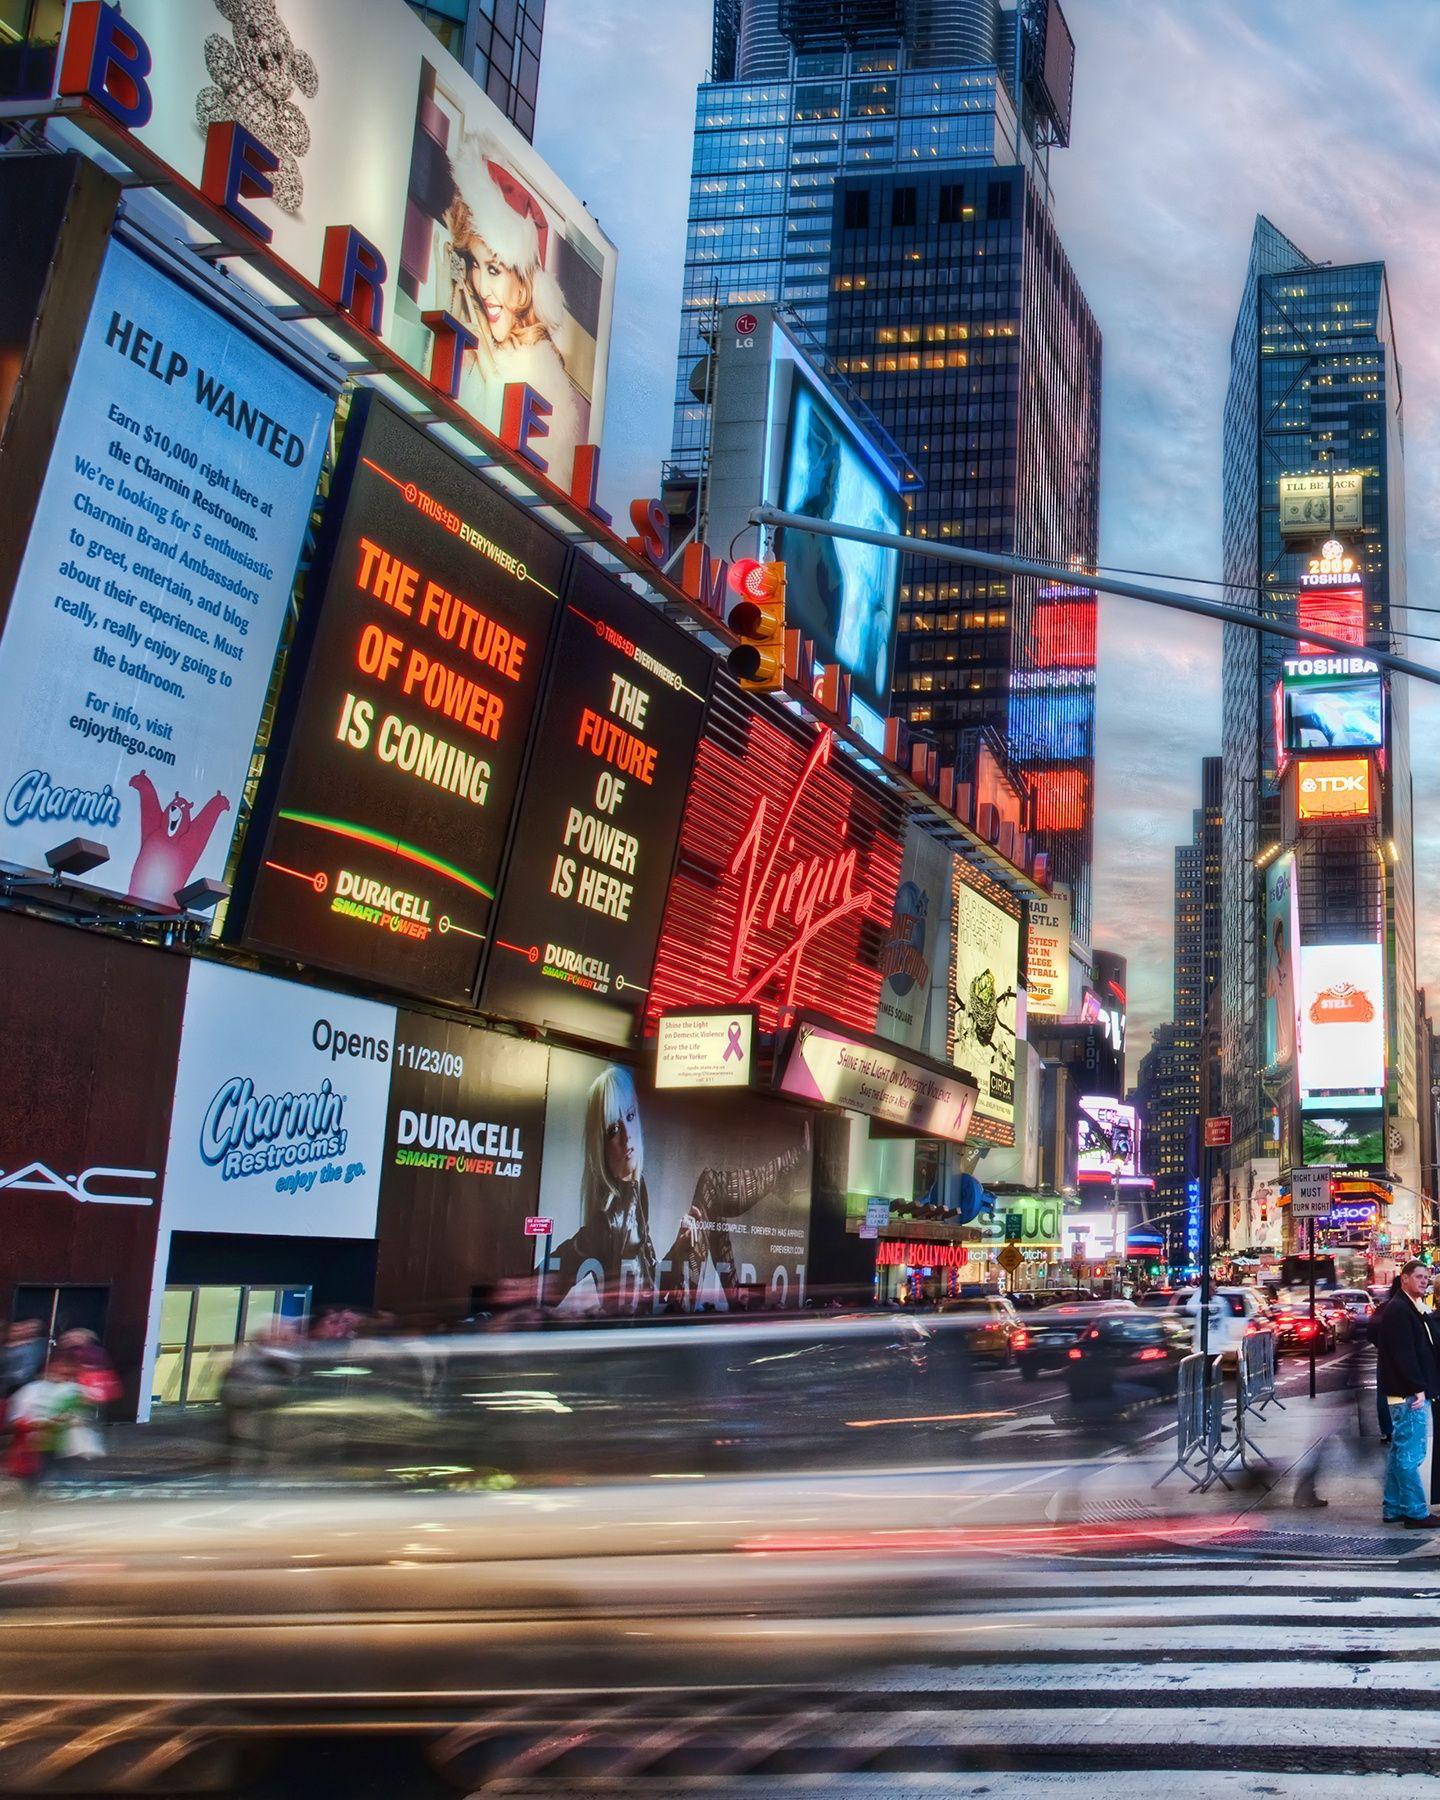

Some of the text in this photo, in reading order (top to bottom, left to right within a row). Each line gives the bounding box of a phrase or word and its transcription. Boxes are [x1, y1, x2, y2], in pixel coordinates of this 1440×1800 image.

[57, 0, 852, 727] BERTELSMNN
[736, 338, 753, 348] LG
[105, 311, 304, 469] HELP WANTED
[107, 403, 274, 518] Earn $10,000 right here at
[1309, 482, 1324, 490] BE
[1326, 480, 1356, 489] ACK
[108, 439, 259, 541] the Charmin Restrooms.
[75, 455, 274, 580] We're looking for 5 enthusiastic
[73, 493, 259, 605] Charmin Brand Ambassadors
[459, 521, 518, 575] EVERYWHERE
[1309, 559, 1353, 574] 2009
[69, 527, 249, 635] to greet, entertain, and blog
[1301, 573, 1361, 585] TOSHIBA
[59, 559, 244, 661] about their experience. Must
[356, 537, 527, 682] THE FUTURE
[54, 593, 232, 688] really, really enjoy going to
[633, 647, 675, 687] EVERYWHERE
[1284, 657, 1379, 676] TOSHIBA
[93, 645, 185, 699] the bathroom.
[358, 625, 504, 741] OF POWER
[85, 691, 173, 741] For info, visit
[609, 673, 649, 730] THE
[69, 714, 176, 767] enjoythego.com
[337, 694, 491, 806] IS COMING
[577, 707, 658, 786] FUTURE
[4, 769, 121, 828] Charmin
[596, 771, 625, 814] OF
[1316, 775, 1365, 793] TDK
[563, 806, 639, 875] POWER
[550, 854, 633, 922] IS HERE
[731, 727, 873, 1010] Virgin
[335, 871, 431, 924] DURACELL
[543, 944, 610, 984] DURACELL
[895, 1008, 913, 1025] SQUARE
[1026, 987, 1055, 996] SPIKE
[312, 1018, 464, 1078] Opens 11/23/09
[693, 1021, 708, 1029] Light
[991, 1075, 1012, 1096] CIRCA
[200, 1077, 346, 1165] Charmin
[397, 1110, 524, 1160] DURACELL
[221, 1128, 348, 1182] Restrooms!
[275, 1163, 366, 1196] enjoy the go.
[495, 1159, 522, 1179] LAB
[1294, 1172, 1328, 1182] RIGHT LANE
[1300, 1187, 1321, 1197] MUST
[1311, 1202, 1329, 1210] RIGHT
[877, 1242, 906, 1265] ANET
[907, 1243, 968, 1266] HOLLYWOOD
